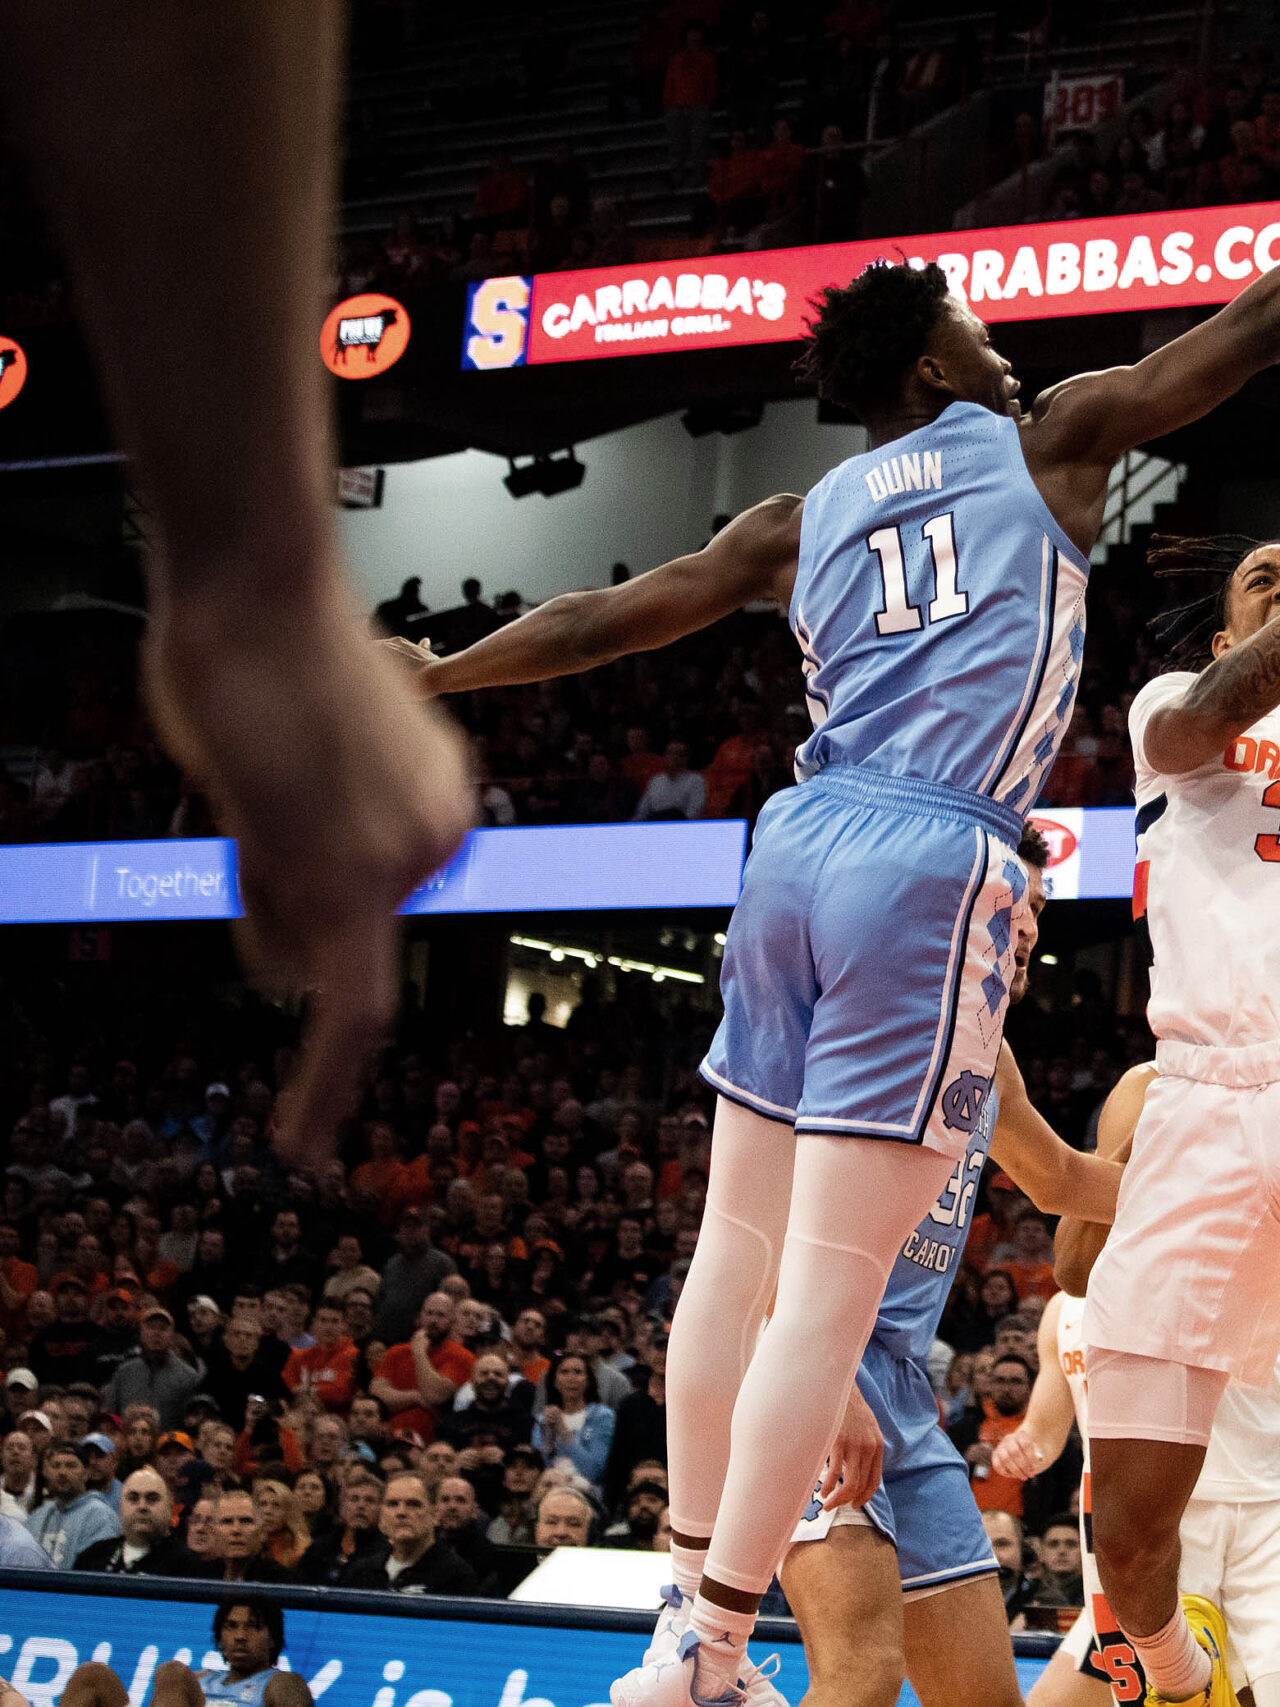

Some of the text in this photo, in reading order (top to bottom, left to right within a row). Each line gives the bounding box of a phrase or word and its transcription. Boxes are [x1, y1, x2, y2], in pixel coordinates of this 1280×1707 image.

[542, 274, 786, 338] CARRABBA'S
[595, 314, 727, 342] ITALIAN GRILL
[865, 452, 942, 502] DUNN
[866, 511, 969, 636] 11
